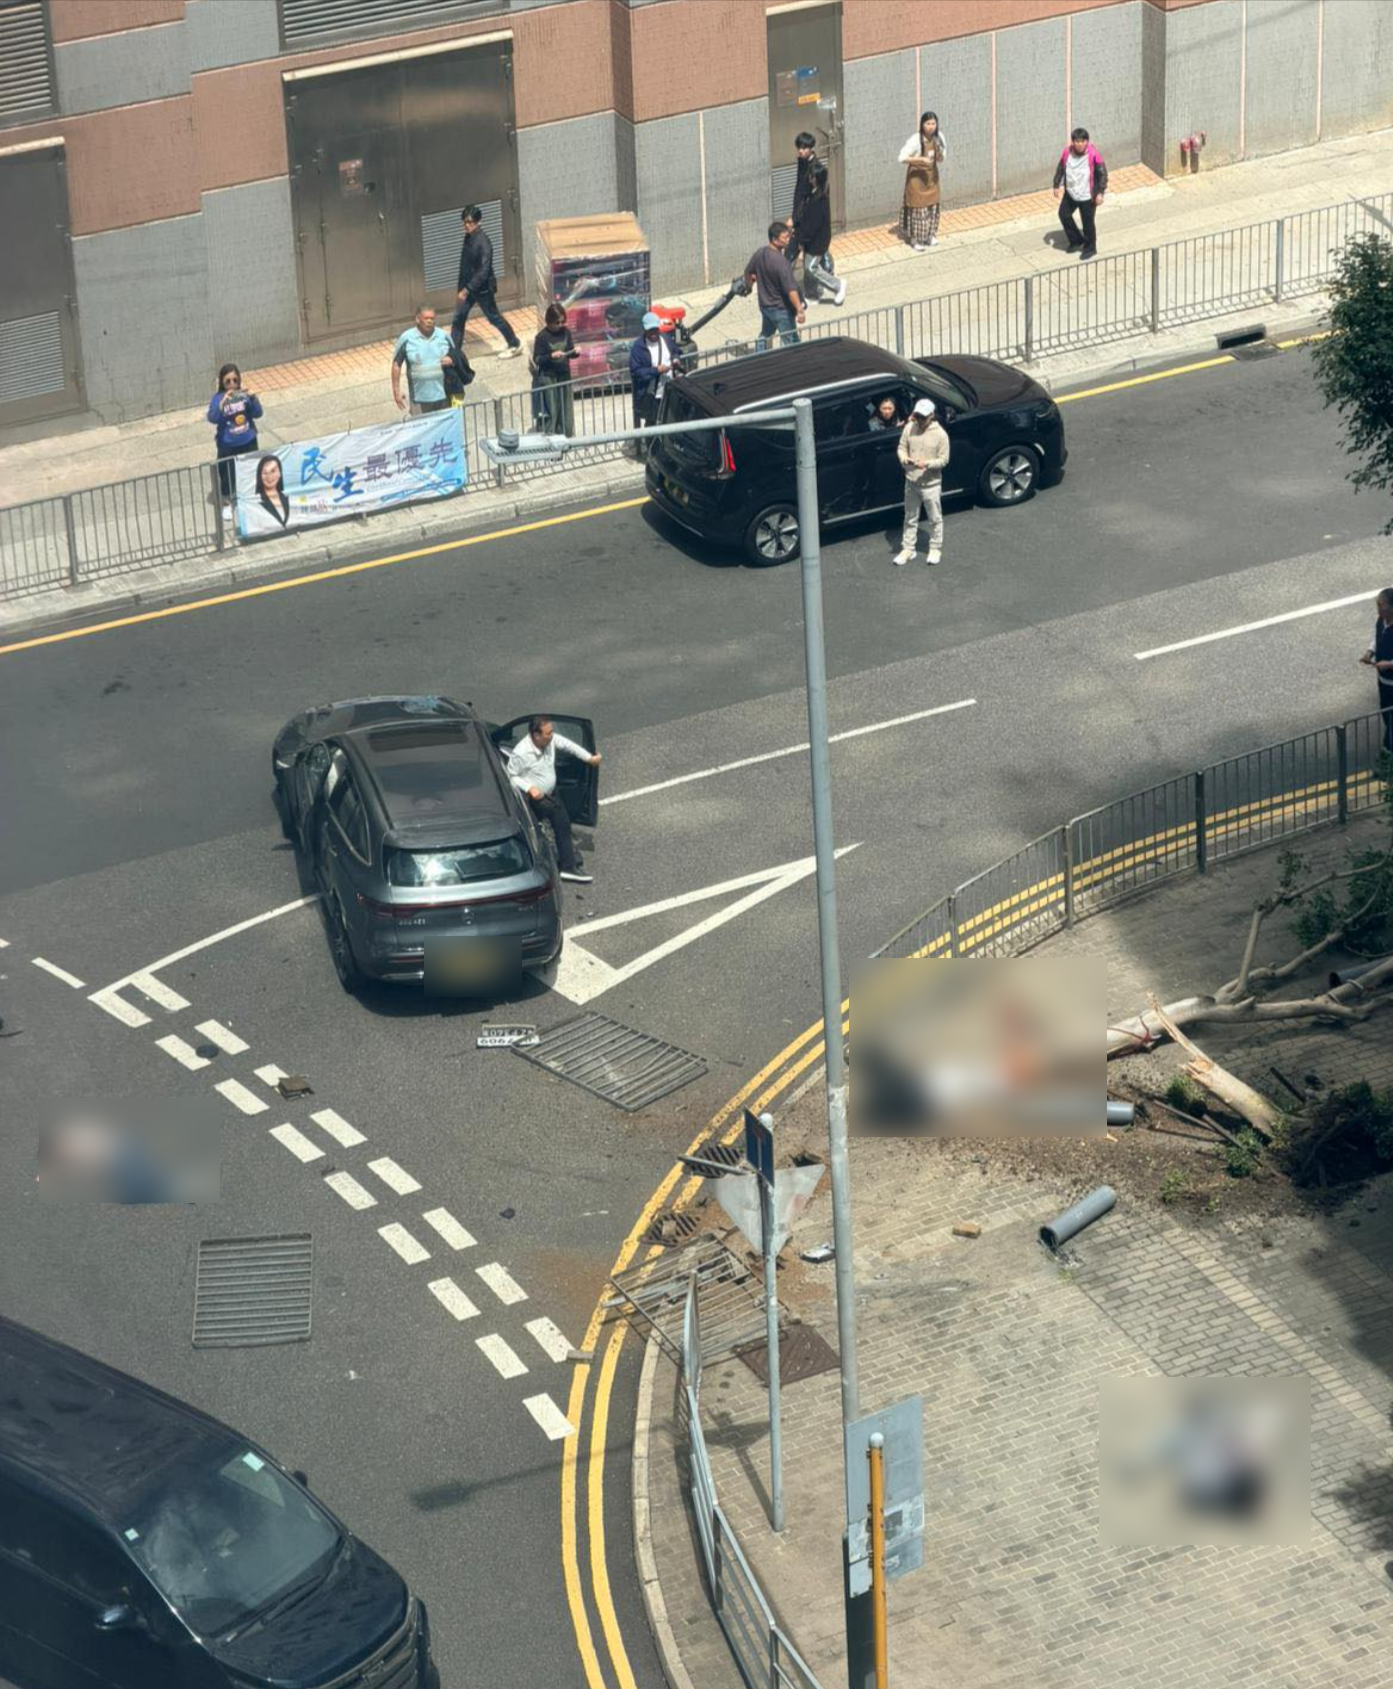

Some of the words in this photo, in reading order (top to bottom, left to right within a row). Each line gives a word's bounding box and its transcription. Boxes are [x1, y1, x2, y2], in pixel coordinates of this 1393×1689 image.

[301, 437, 458, 501] 民生最優先
